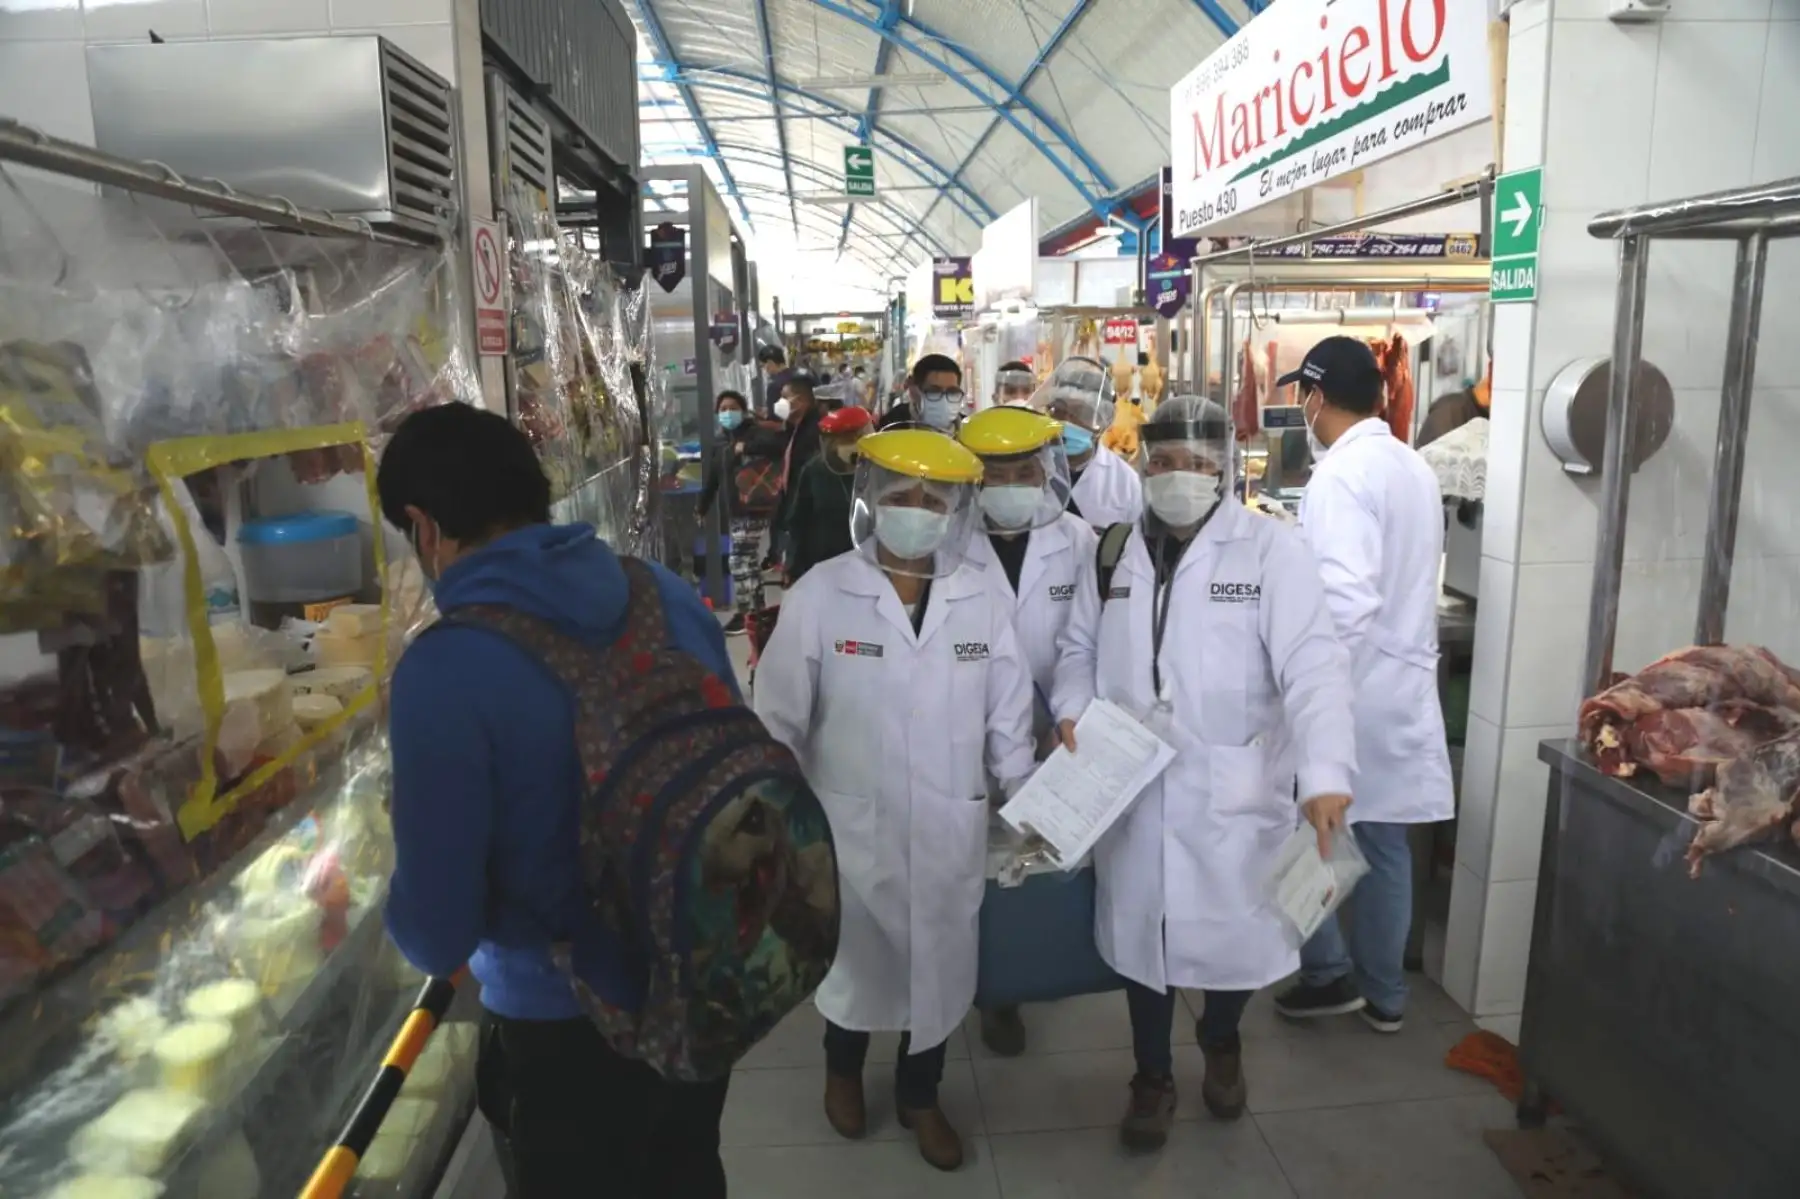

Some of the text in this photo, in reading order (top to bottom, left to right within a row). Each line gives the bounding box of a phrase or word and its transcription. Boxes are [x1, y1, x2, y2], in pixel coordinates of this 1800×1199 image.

[1192, 0, 1446, 181] Maricielo
[1259, 93, 1467, 197] El mejor lugar para comprar
[1179, 188, 1237, 232] Puesto 430
[1492, 266, 1534, 291] SALIDA
[1210, 583, 1261, 597] DIGESA
[953, 642, 990, 656] DIGESA
